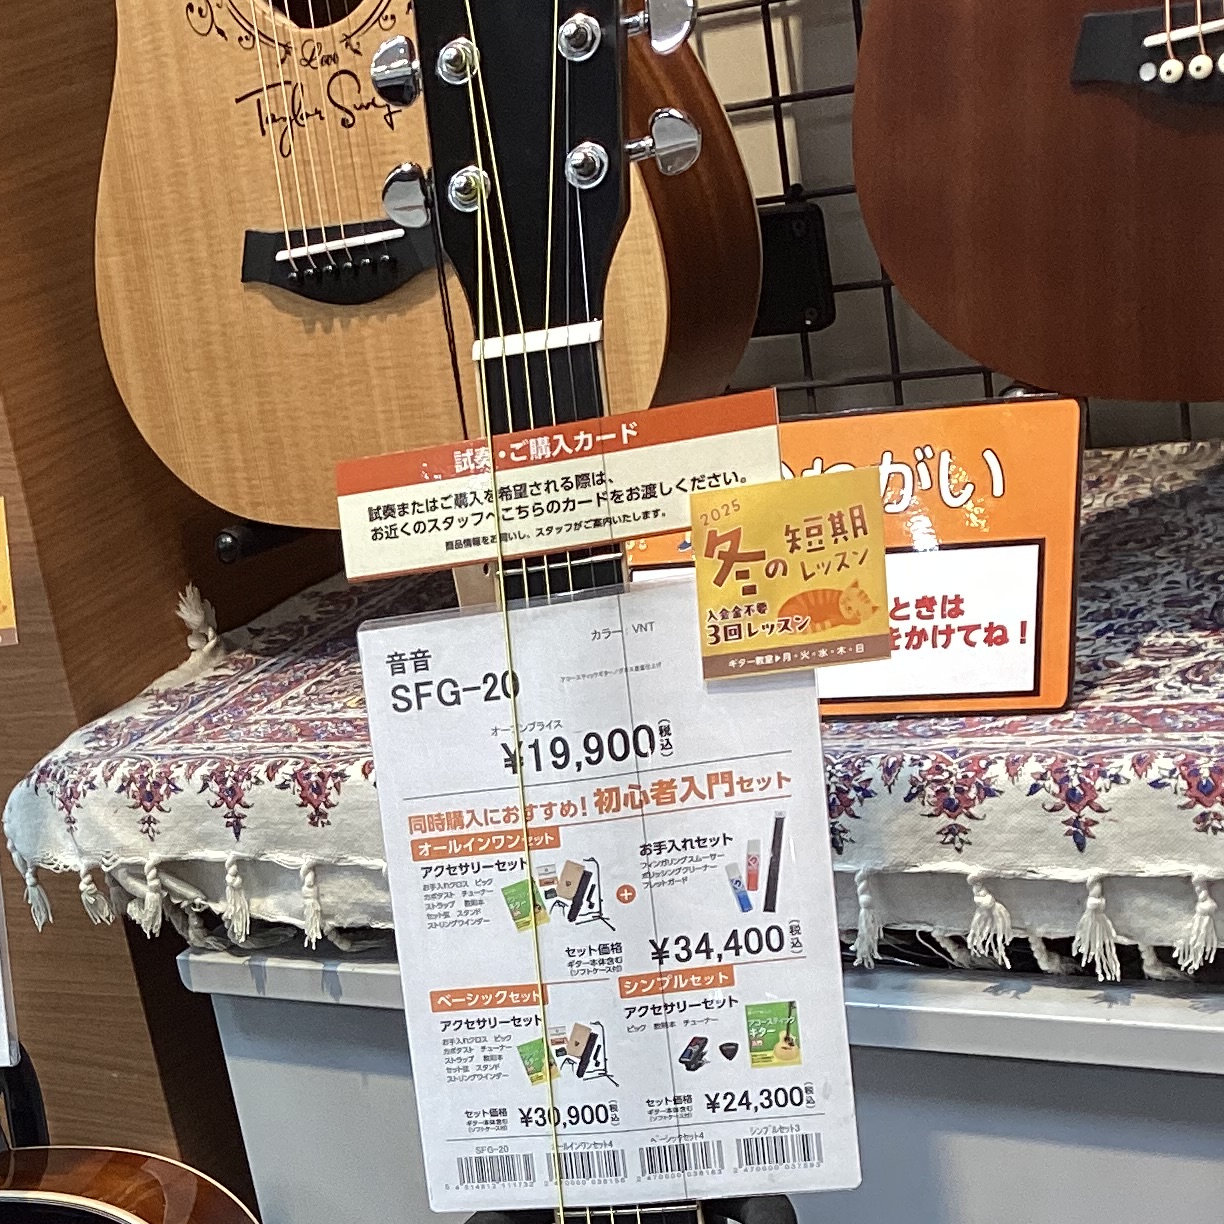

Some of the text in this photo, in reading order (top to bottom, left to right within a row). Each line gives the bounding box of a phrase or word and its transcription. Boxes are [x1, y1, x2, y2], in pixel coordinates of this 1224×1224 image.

[700, 499, 741, 526] 2025
[784, 504, 868, 554] 短期
[800, 547, 869, 581] レッスン
[706, 615, 811, 645] 3回レッスン
[384, 648, 433, 677] 音音
[391, 669, 520, 715] SFG-20
[501, 722, 657, 775] ¥19,900
[593, 770, 793, 816] 初心者入門セット
[417, 832, 556, 857] オールインワンセット
[638, 832, 734, 857] お手入れセット
[420, 857, 528, 879] アクセサリーセット
[565, 941, 623, 958] セット価格
[649, 924, 786, 966] ¥34,400
[623, 972, 730, 994] シンプルセット
[436, 990, 541, 1007] ベーシックセット
[624, 995, 740, 1020] アクセサリーセット
[439, 1014, 543, 1033] アクセサリーセット
[645, 1094, 693, 1107] セット価格
[704, 1085, 804, 1114] ¥24,300
[464, 1107, 508, 1119] セット価格
[518, 1102, 609, 1130] ¥30,900
[475, 1145, 509, 1155] SFG-20
